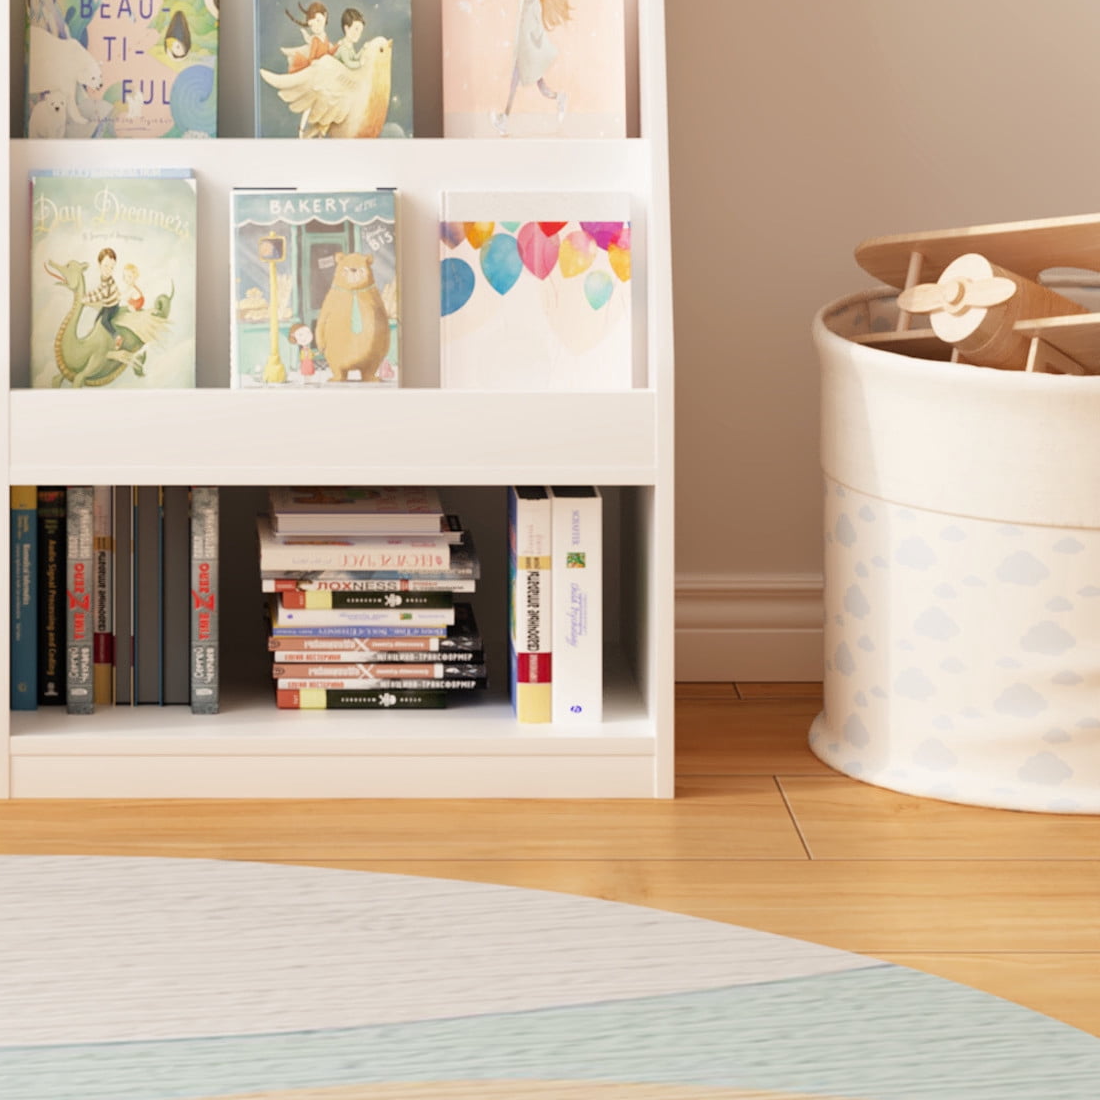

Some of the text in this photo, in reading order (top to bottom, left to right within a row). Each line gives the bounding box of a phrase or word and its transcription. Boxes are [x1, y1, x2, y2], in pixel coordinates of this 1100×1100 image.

[103, 36, 145, 61] TI-
[121, 79, 171, 105] FUL
[33, 192, 84, 234] Day
[269, 198, 351, 214] BAKERY
[46, 539, 57, 562] Audio
[46, 564, 57, 589] Signal
[46, 590, 57, 631] Processing
[46, 632, 57, 647] and
[73, 612, 85, 641] TIME
[198, 612, 210, 641] TIME
[46, 648, 57, 676] Coding
